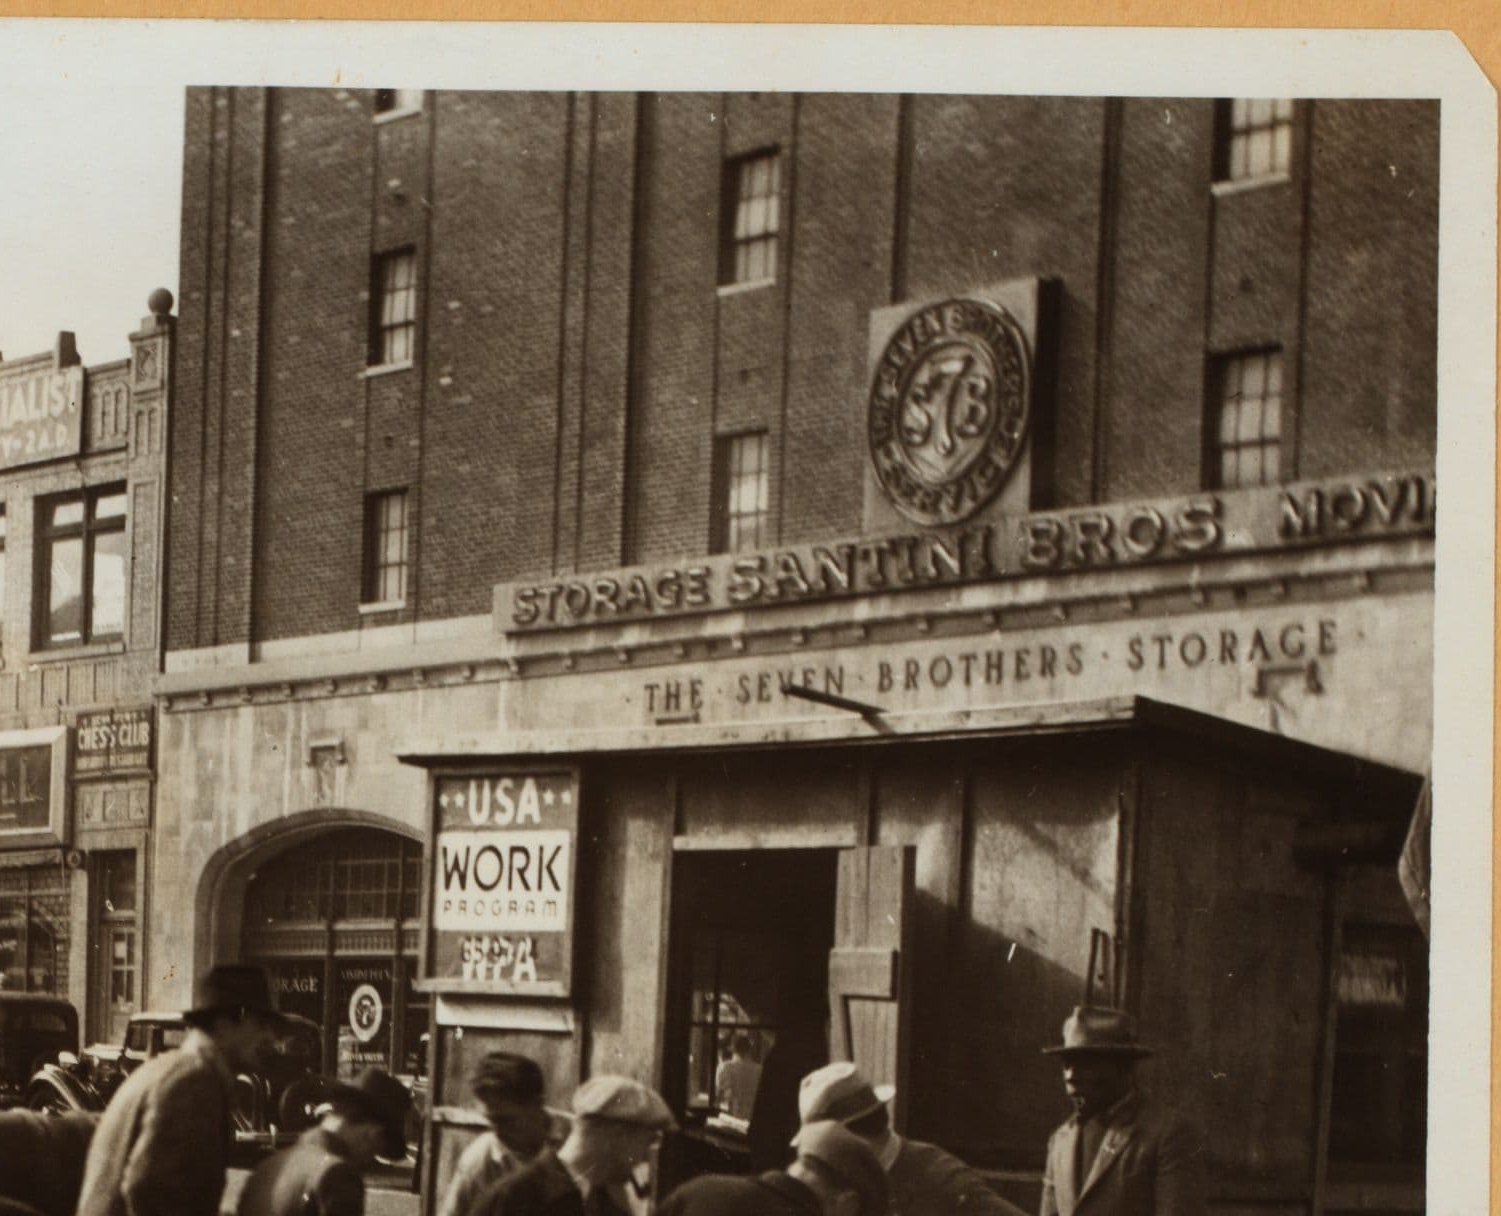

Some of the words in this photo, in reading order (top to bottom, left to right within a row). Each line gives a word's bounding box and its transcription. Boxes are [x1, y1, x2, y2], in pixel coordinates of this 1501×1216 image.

[512, 568, 711, 624] STORAGE
[729, 524, 994, 600] SANTINI
[1022, 497, 1224, 568] BROS
[645, 679, 703, 712] THE
[738, 665, 844, 704] SEVEN
[878, 642, 1084, 692] BROTHERS
[1127, 619, 1337, 671] STORAGE
[78, 725, 116, 751] CHESS
[118, 722, 150, 747] CLUB
[468, 777, 542, 825] USA
[441, 845, 563, 892] WORK
[442, 900, 558, 918] PROGRAM
